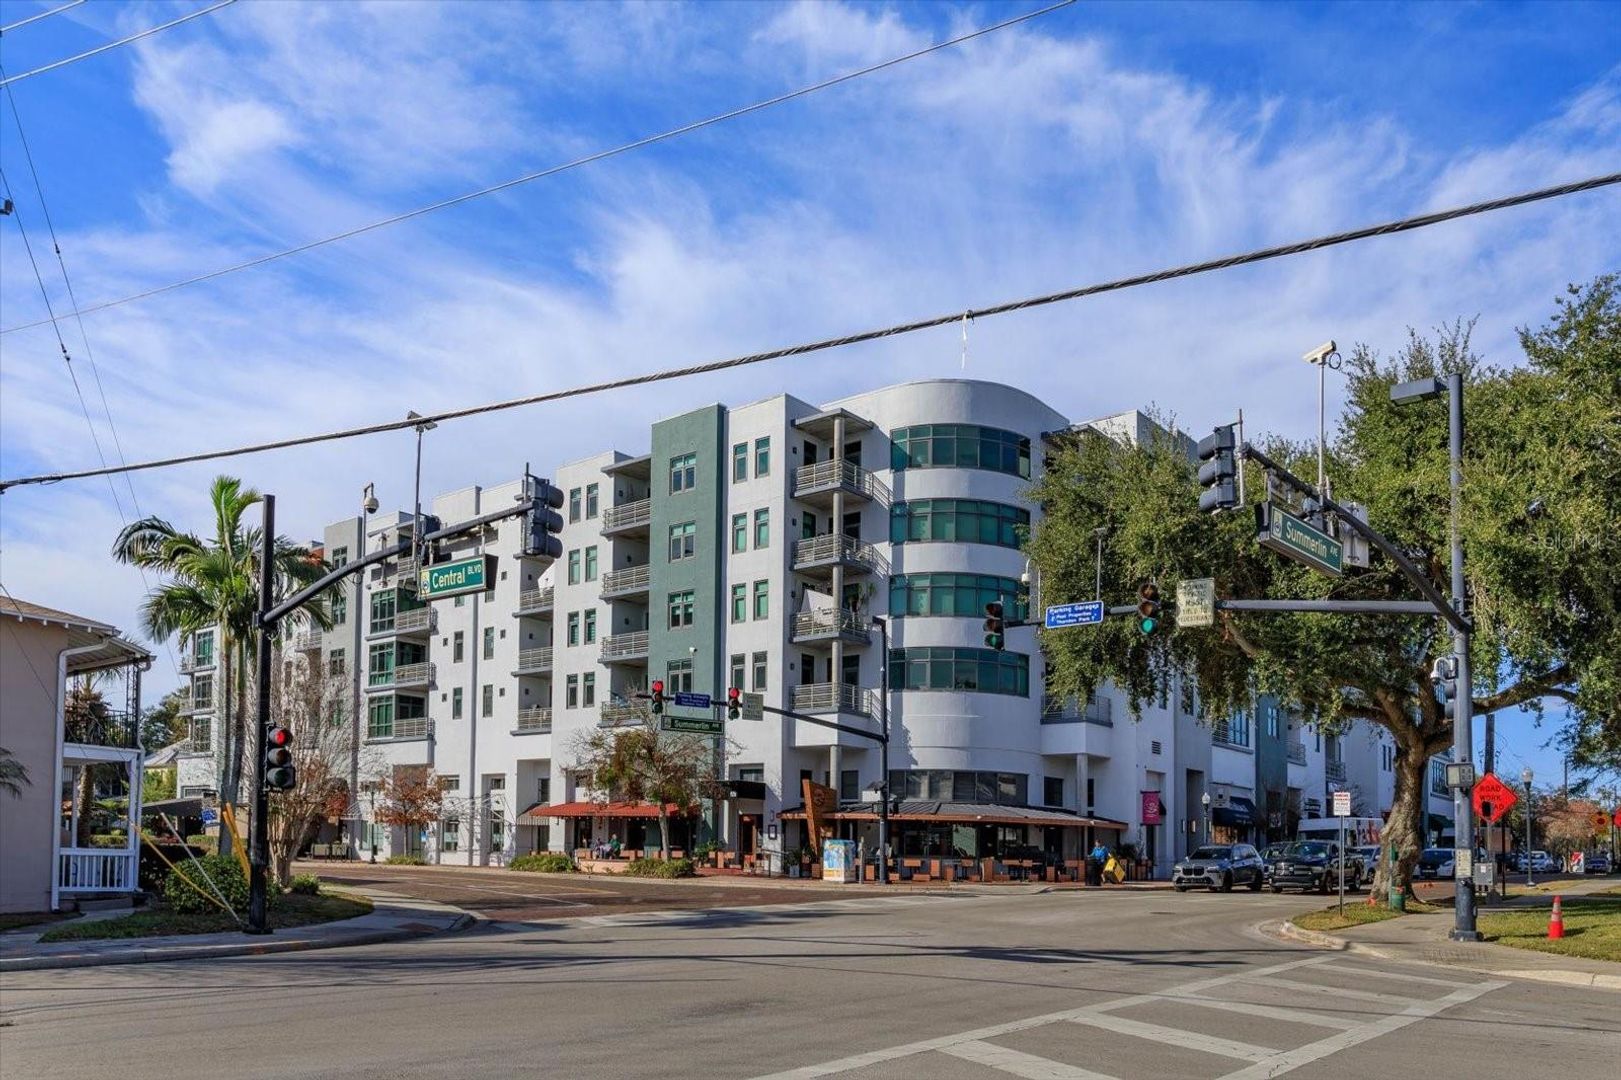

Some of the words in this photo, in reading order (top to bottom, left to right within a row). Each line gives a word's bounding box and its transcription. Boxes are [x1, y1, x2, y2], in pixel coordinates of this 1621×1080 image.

[1286, 521, 1327, 558] Summerlin
[432, 567, 465, 588] Central
[467, 565, 482, 575] BLVD
[1049, 606, 1072, 615] Parking
[1480, 784, 1501, 792] ROAD
